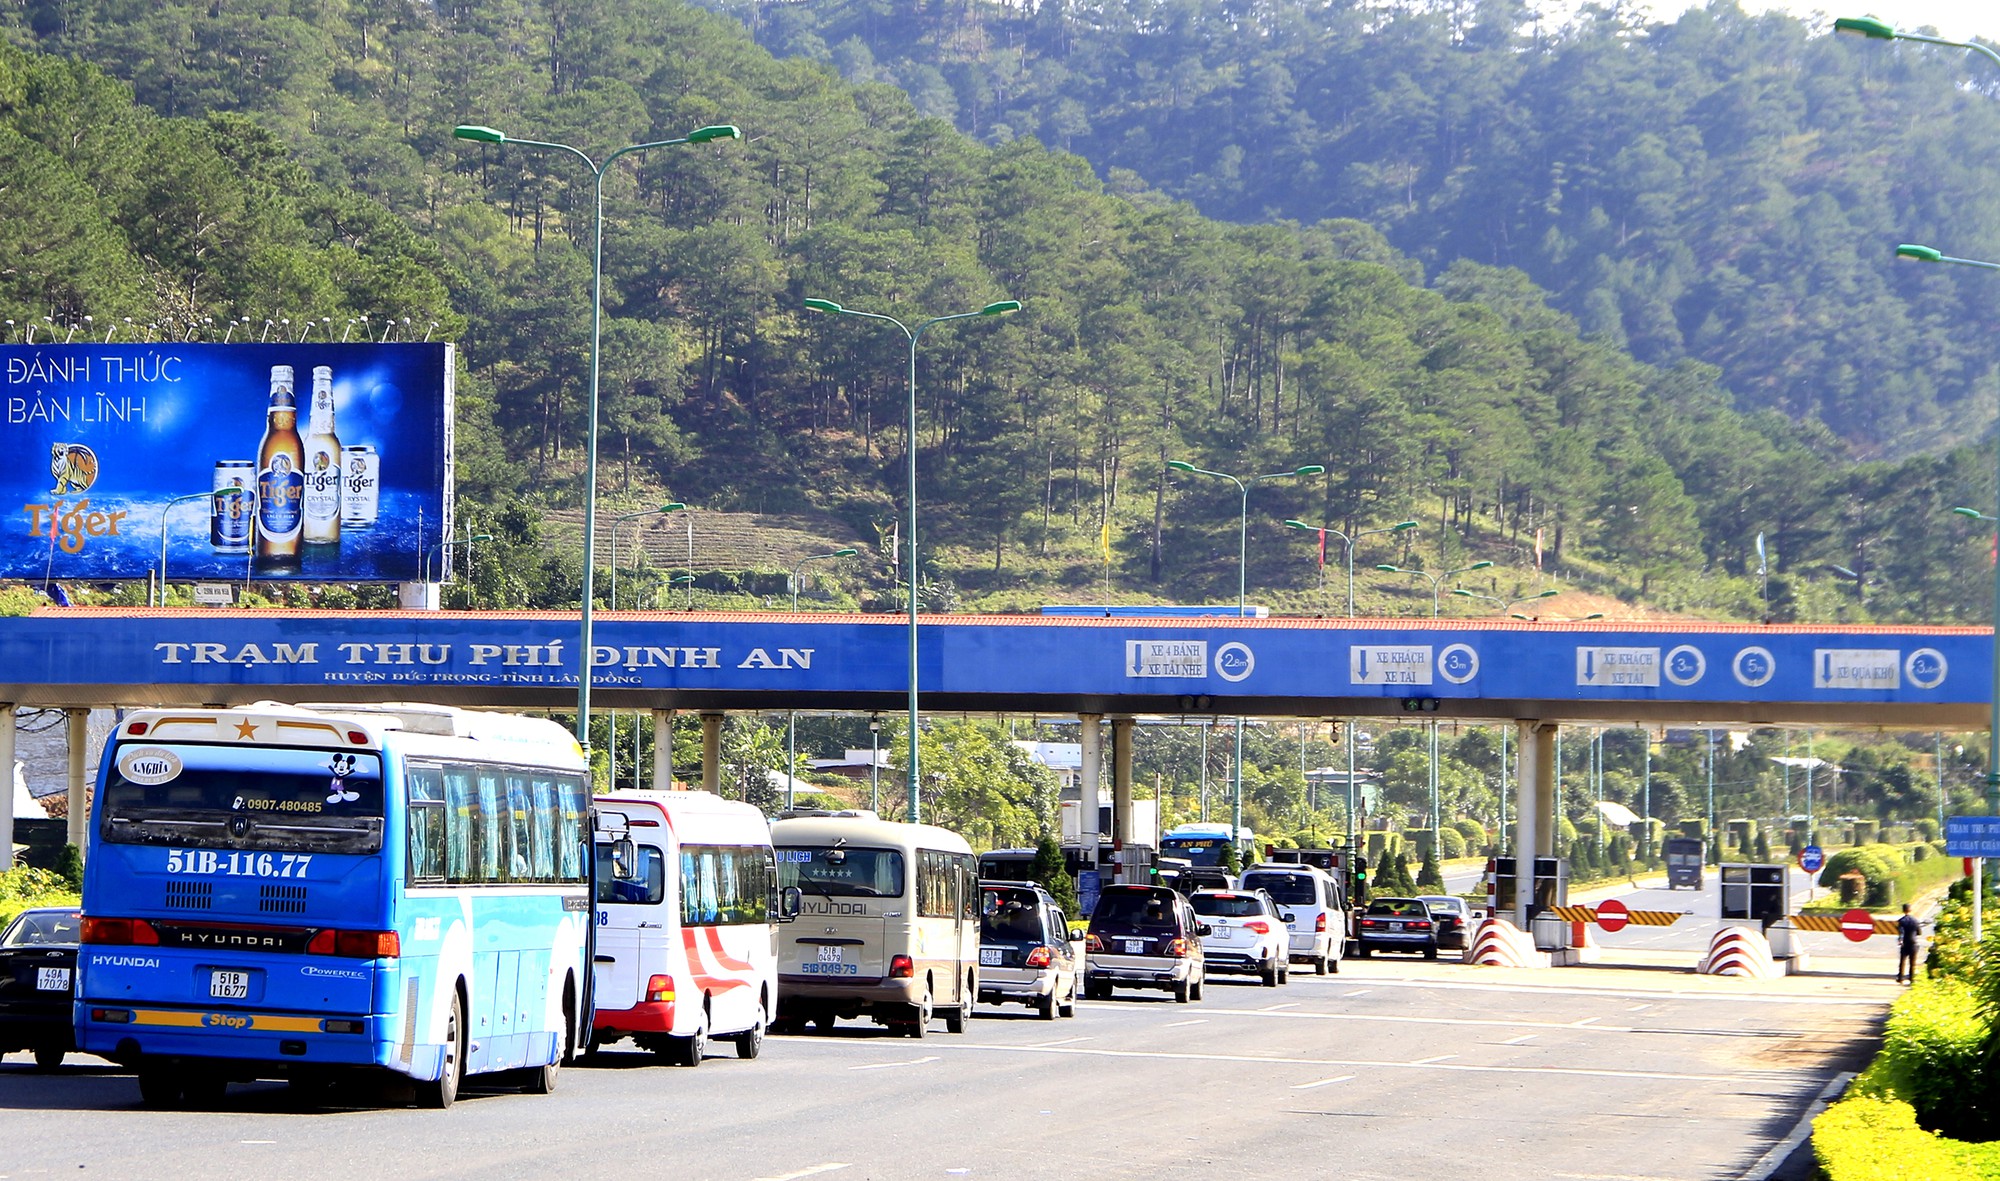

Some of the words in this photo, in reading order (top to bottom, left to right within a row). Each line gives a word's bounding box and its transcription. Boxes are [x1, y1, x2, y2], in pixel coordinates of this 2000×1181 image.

[7, 351, 90, 384] ĐÁNH
[101, 350, 182, 384] THỨC
[8, 390, 70, 423] BẢN
[81, 391, 146, 423] LĨNH
[304, 471, 339, 492] Tiger
[342, 474, 374, 493] Tiger
[260, 479, 302, 508] Tiger
[216, 497, 254, 519] Tiger
[23, 498, 127, 554] Tiger
[154, 642, 319, 668] TRẠM
[337, 643, 452, 665] THU
[467, 639, 564, 667] PHÍ
[590, 645, 721, 672] ĐỊNH
[737, 648, 816, 670] AN
[1151, 645, 1164, 656] XE
[1165, 645, 1171, 656] 4
[1173, 642, 1200, 656] BÁNH
[1376, 652, 1389, 663] XE
[1391, 649, 1424, 663] KHÁCH
[1449, 655, 1467, 669] 3m
[1603, 653, 1616, 664] XE
[1618, 651, 1653, 665] KHÁCH
[1148, 664, 1161, 675] XE
[1162, 660, 1180, 675] TẢI
[1385, 671, 1398, 682] XE
[1400, 667, 1416, 683] TẢI
[1837, 666, 1849, 678] XE
[324, 670, 387, 683] HUYỆN
[391, 669, 427, 681] ĐỨC
[592, 670, 642, 684] ĐỒNG
[1612, 672, 1625, 683] XE
[132, 760, 168, 775] A.NGHĨA
[247, 799, 322, 813] 0907.480485
[1180, 840, 1193, 848] AN
[166, 848, 312, 879] 51B-116.77
[777, 850, 784, 863] U
[787, 850, 812, 865] LỊCH
[181, 933, 283, 946] HYUNDAI
[823, 946, 837, 954] 51B
[92, 955, 160, 968] HYUNDAI
[45, 968, 63, 979] 49A
[220, 973, 239, 984] 51B
[212, 984, 246, 996] 116.77
[210, 1013, 247, 1029] Stop
